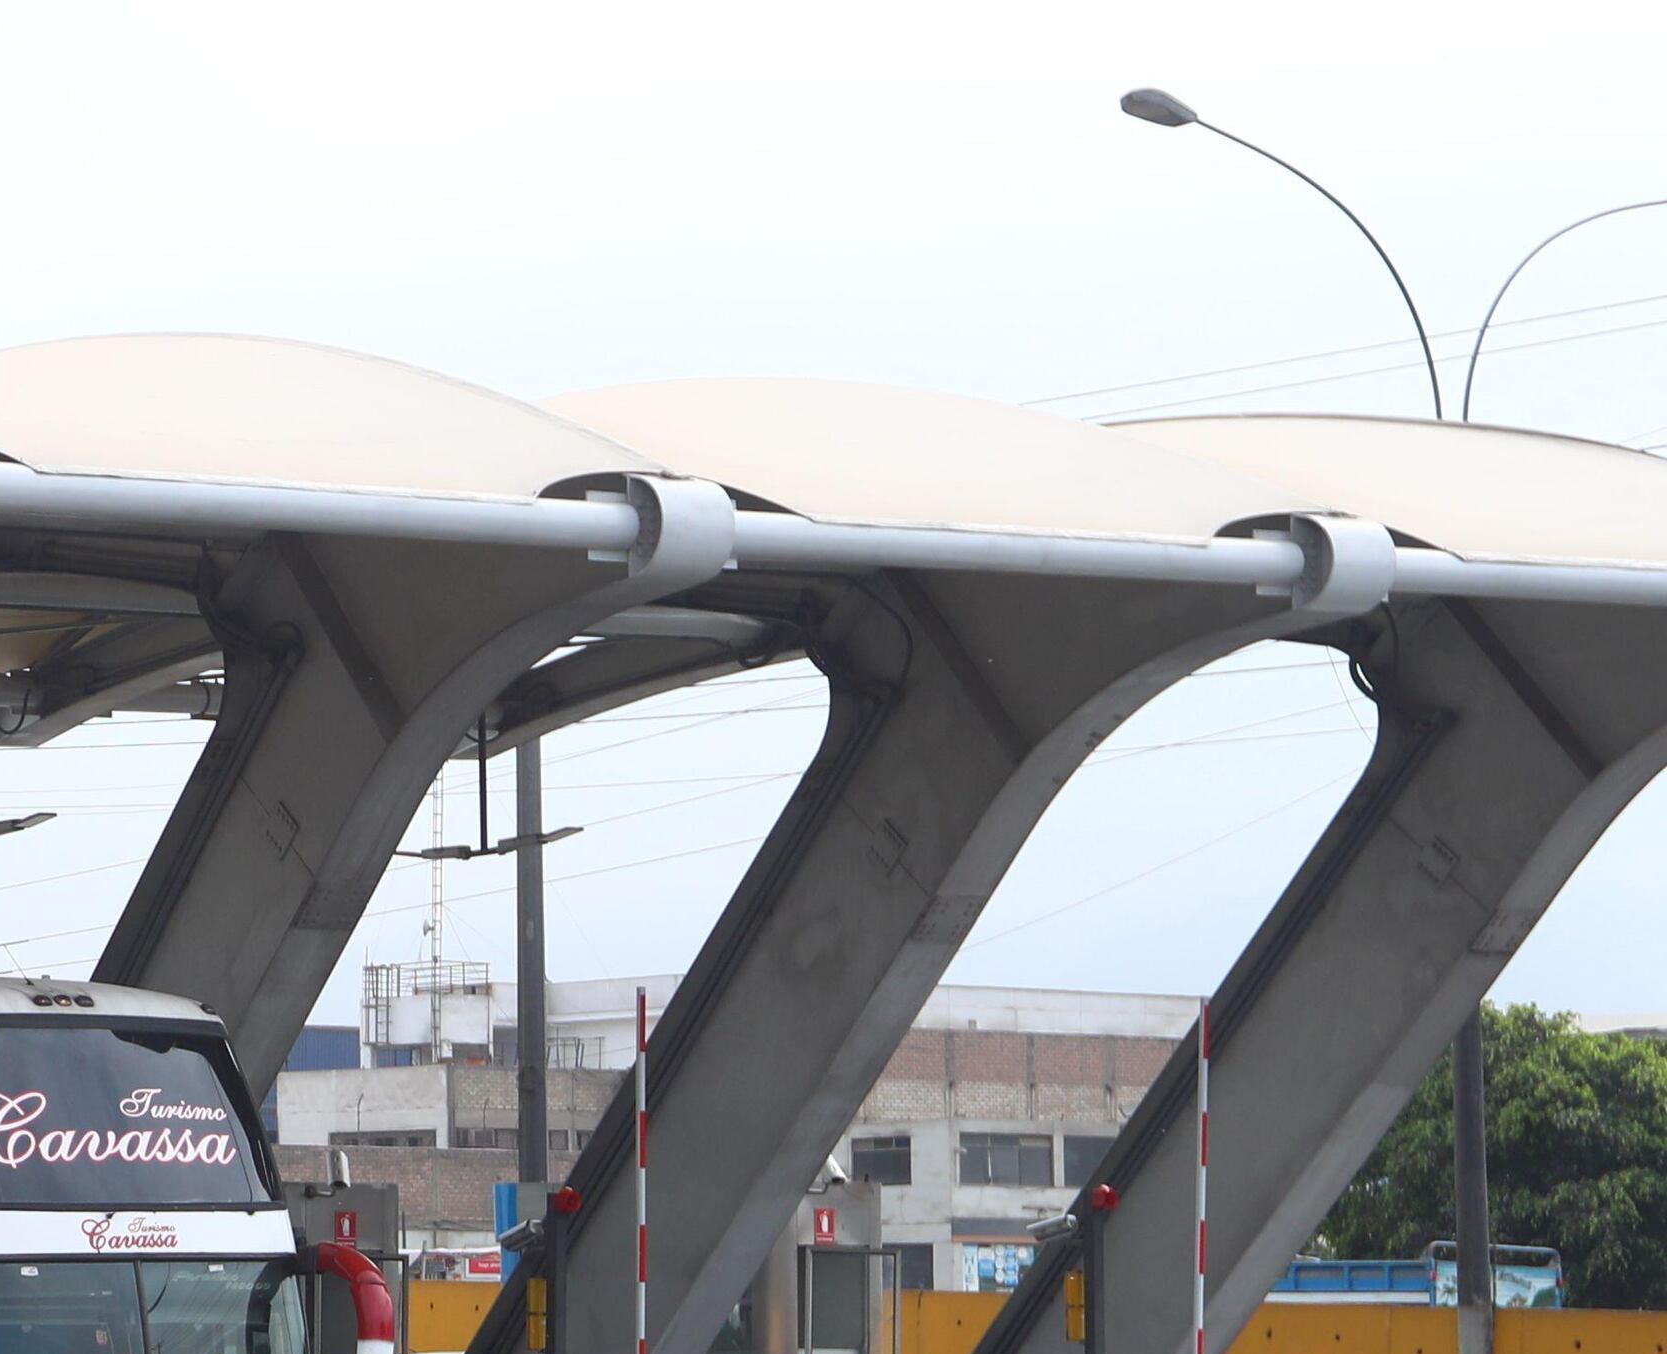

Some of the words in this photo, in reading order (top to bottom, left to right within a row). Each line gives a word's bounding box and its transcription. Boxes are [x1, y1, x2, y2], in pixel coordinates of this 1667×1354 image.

[119, 1087, 227, 1122] Turismo
[81, 1218, 178, 1254] Cavassa
[127, 1217, 176, 1233] Turismo
